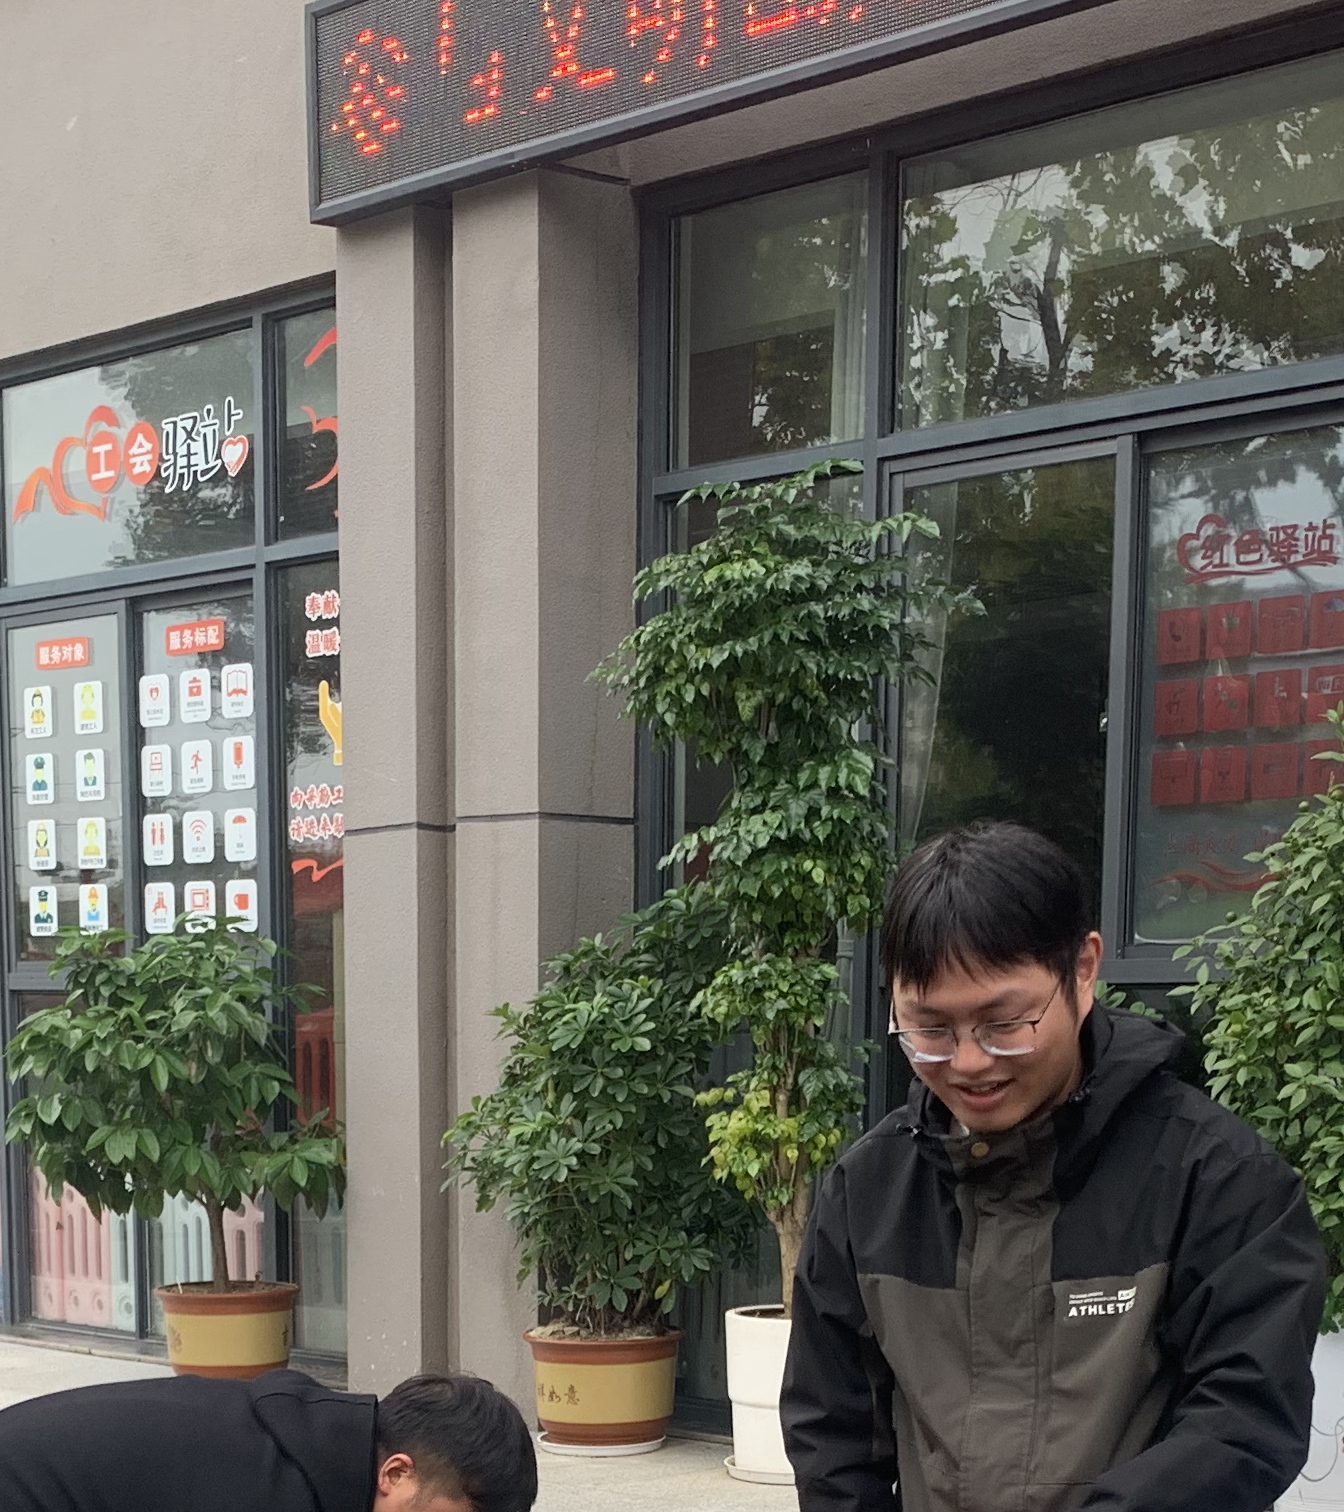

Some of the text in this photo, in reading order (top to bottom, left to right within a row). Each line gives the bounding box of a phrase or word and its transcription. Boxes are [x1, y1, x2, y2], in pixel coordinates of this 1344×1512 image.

[1199, 518, 1336, 572] 红色驿站
[305, 589, 341, 621] 奉献
[169, 625, 220, 651] 服务标配
[305, 626, 341, 658] 温暖
[39, 643, 85, 666] 服务对象
